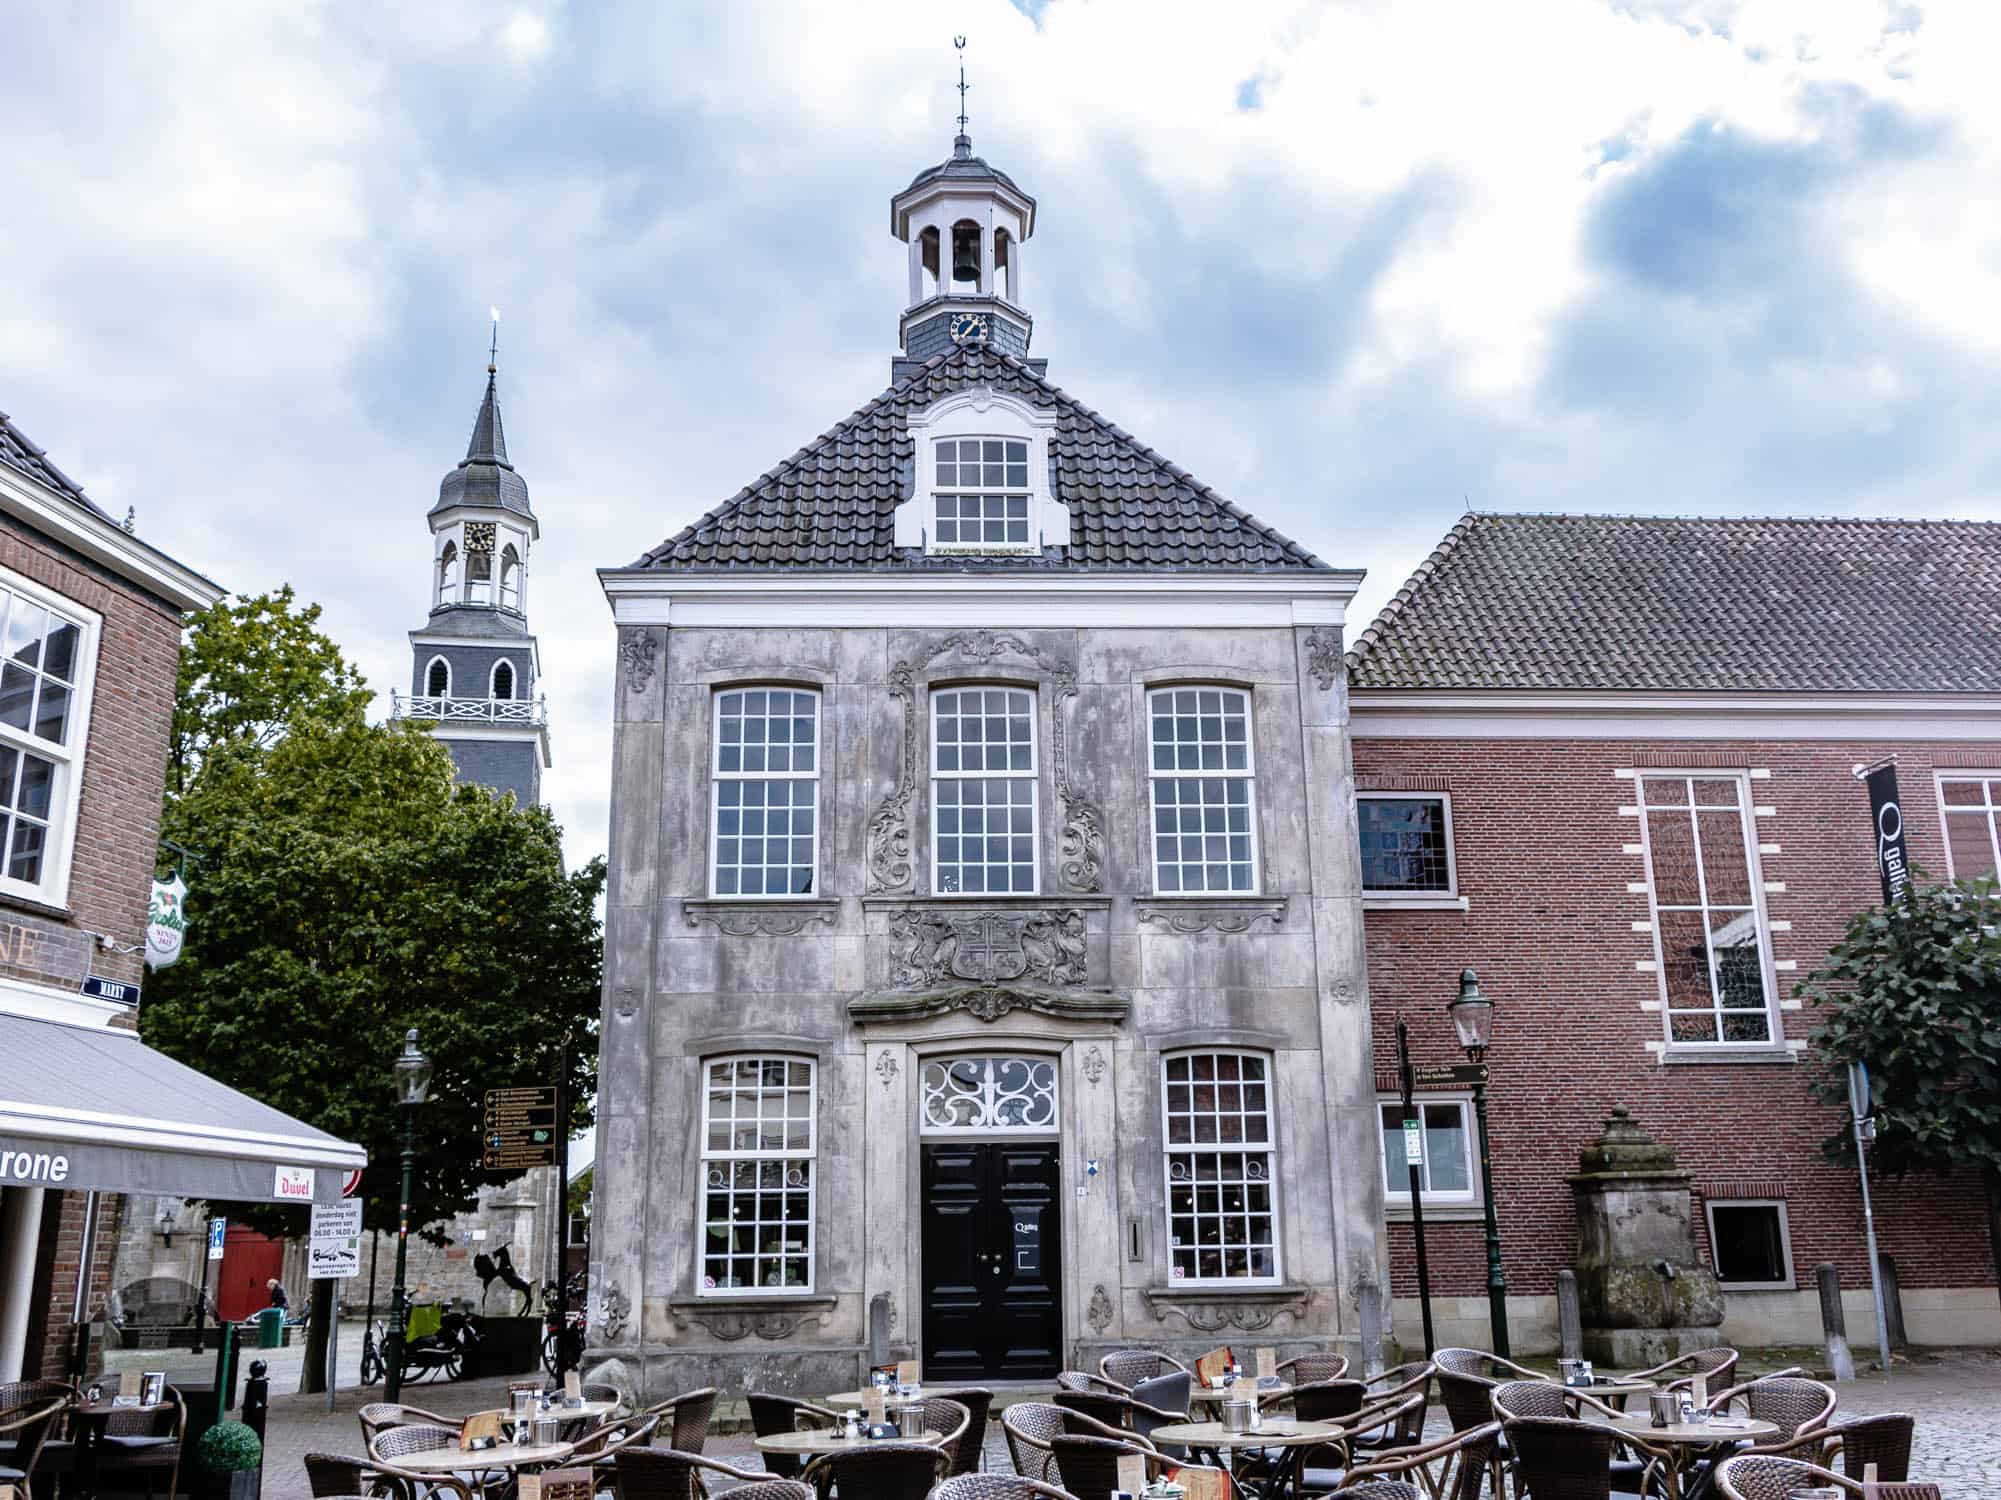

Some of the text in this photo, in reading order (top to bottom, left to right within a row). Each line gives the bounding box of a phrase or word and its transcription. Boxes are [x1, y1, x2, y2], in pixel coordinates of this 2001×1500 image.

[99, 981, 125, 1000] MARKT
[0, 1151, 69, 1182] rone
[281, 1176, 310, 1196] Duvel
[215, 1222, 223, 1235] P
